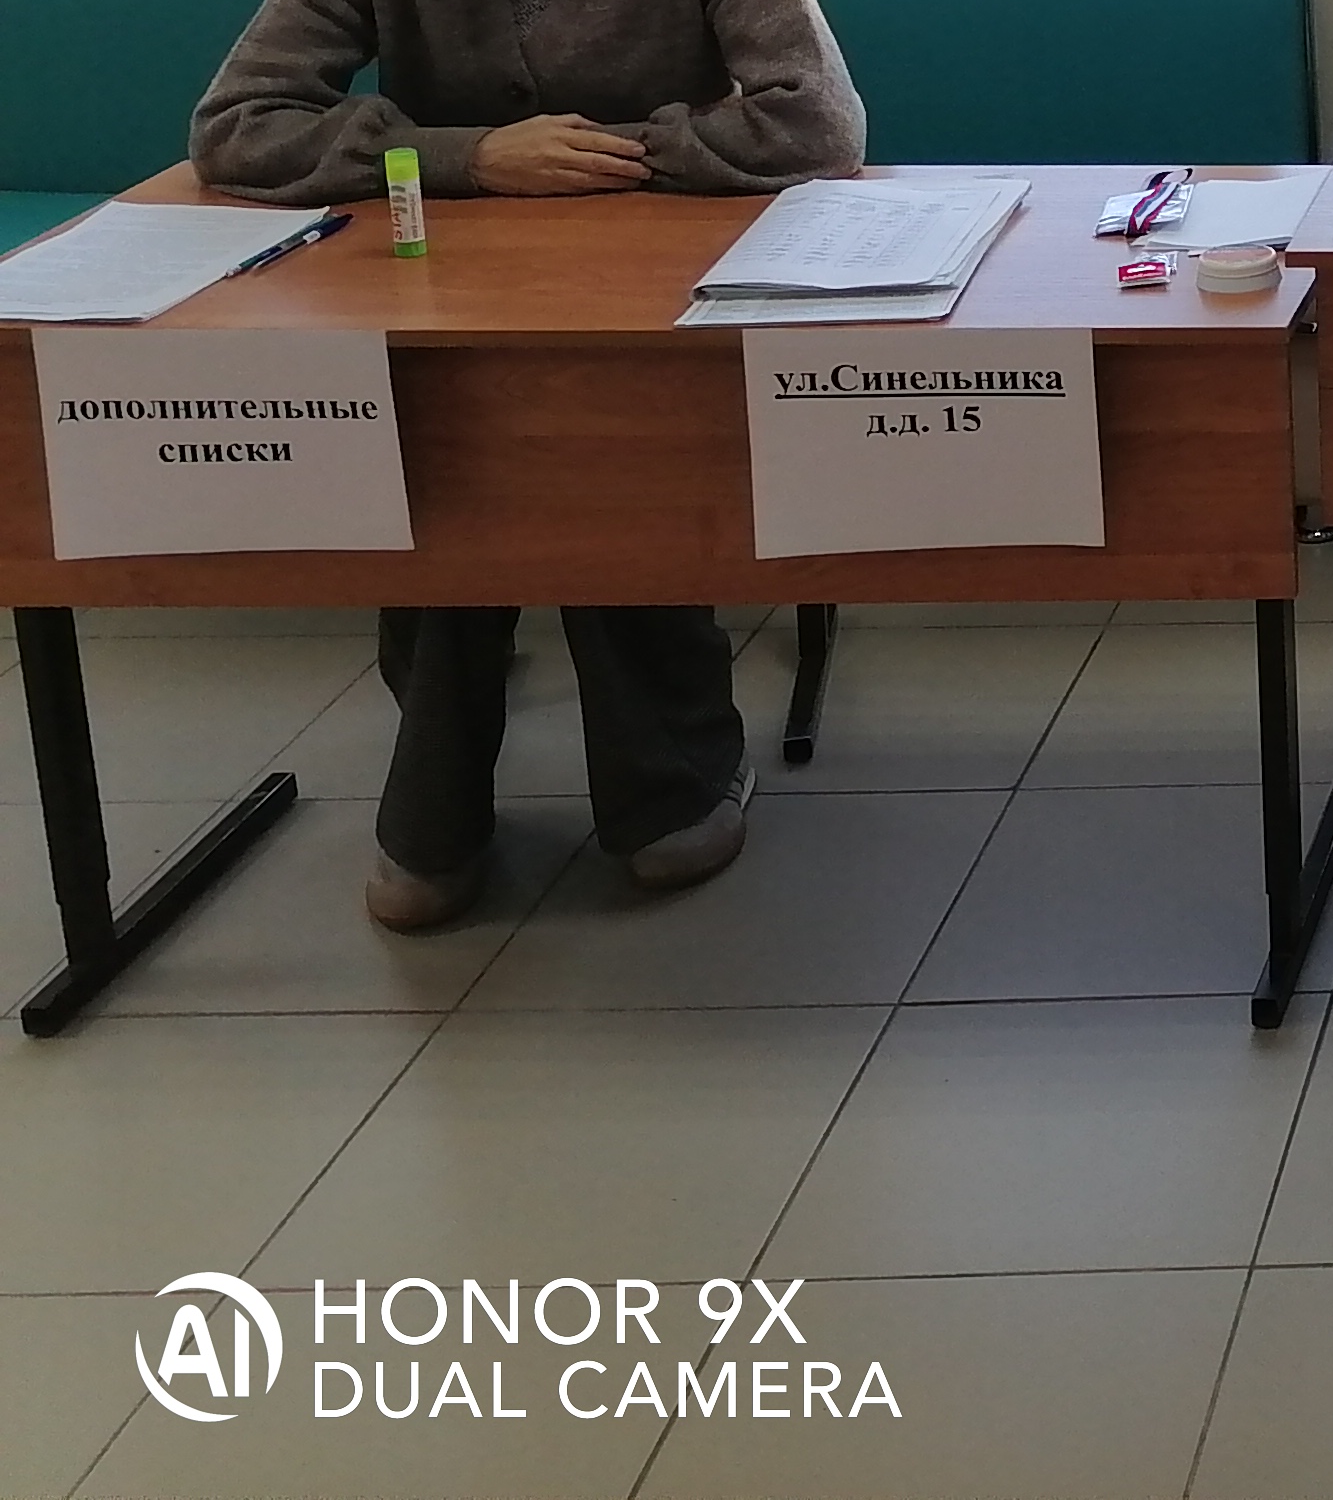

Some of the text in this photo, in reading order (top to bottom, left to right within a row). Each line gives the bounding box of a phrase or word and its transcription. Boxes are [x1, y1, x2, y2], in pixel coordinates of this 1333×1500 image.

[772, 363, 1066, 397] ул.Синельника
[56, 398, 379, 425] дополнительные
[865, 404, 983, 438] д.д. 15
[157, 440, 294, 464] списки
